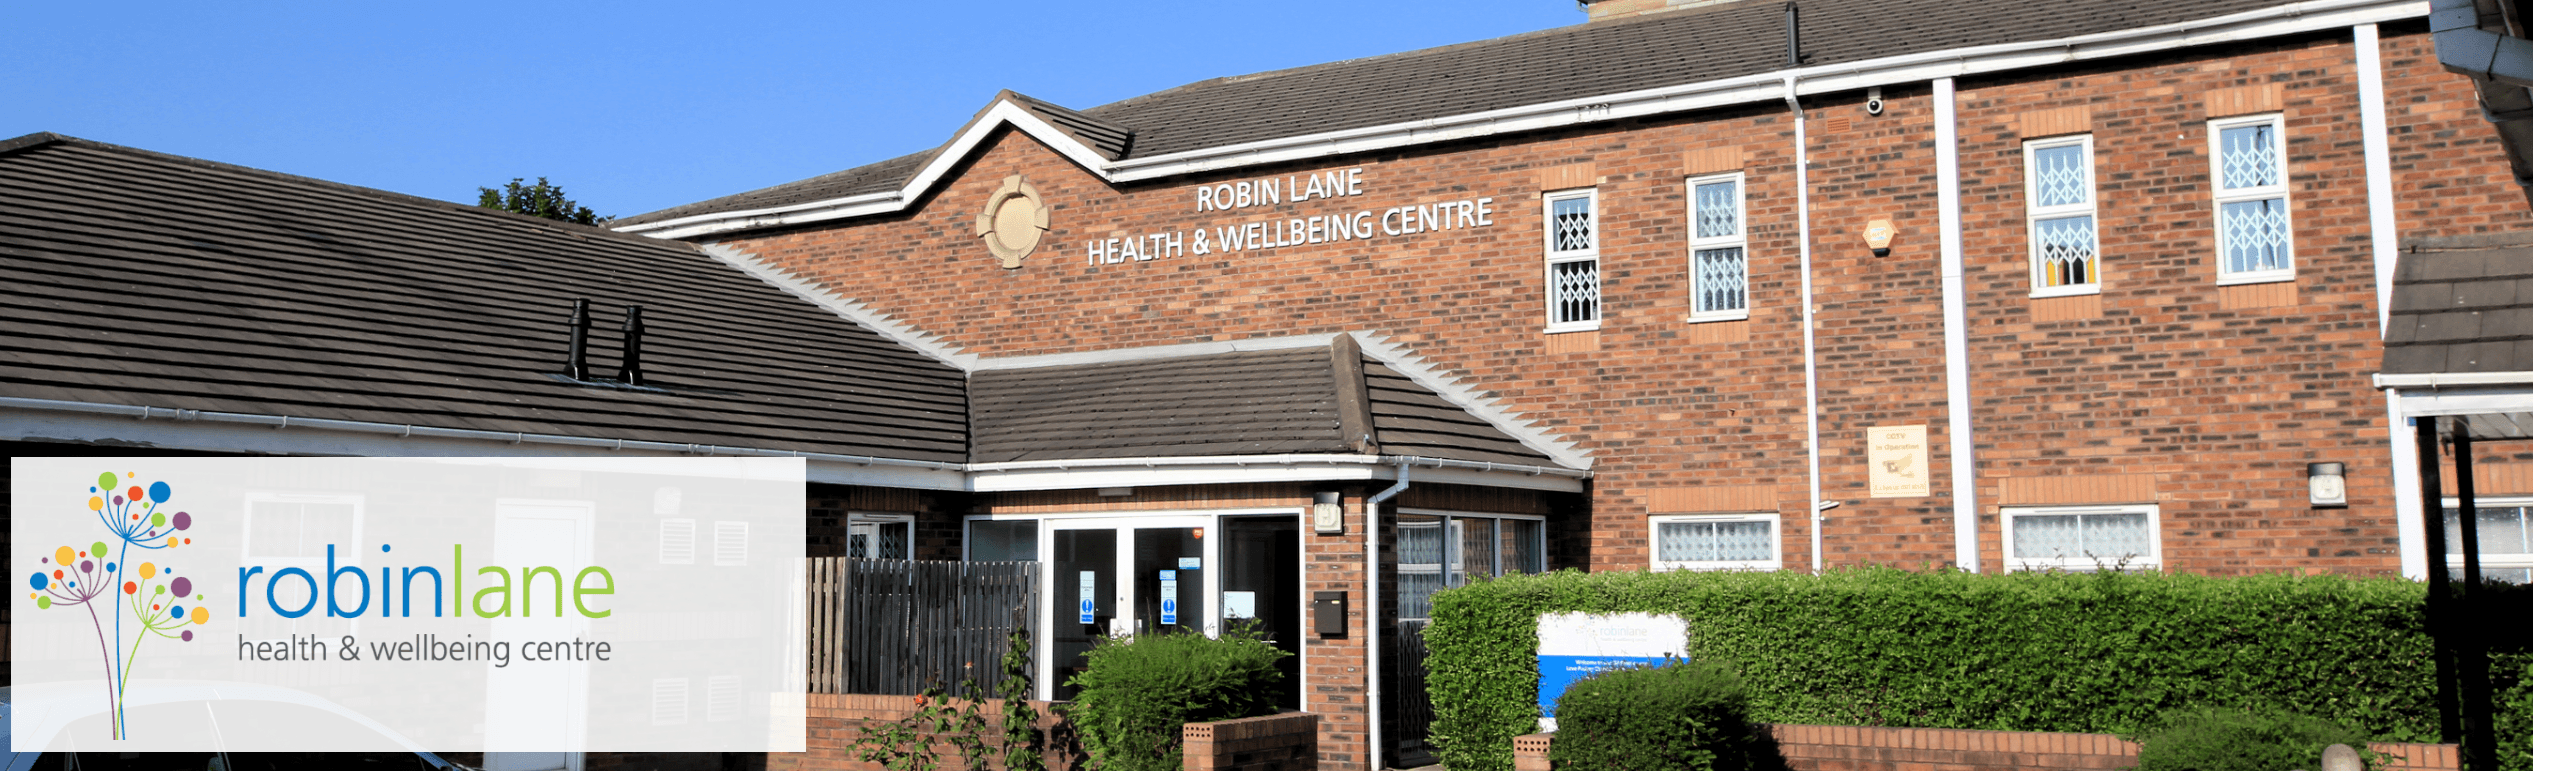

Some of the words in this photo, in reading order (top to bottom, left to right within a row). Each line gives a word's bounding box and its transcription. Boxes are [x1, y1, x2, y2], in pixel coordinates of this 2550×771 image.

[1197, 178, 1280, 212] ROBIN
[1290, 168, 1363, 202] LANE
[1088, 231, 1183, 266] HEALTH
[1192, 228, 1210, 255] &
[1217, 211, 1373, 253] WELLBEING
[1382, 197, 1493, 236] CENTRE
[1600, 625, 1647, 636] robinlane
